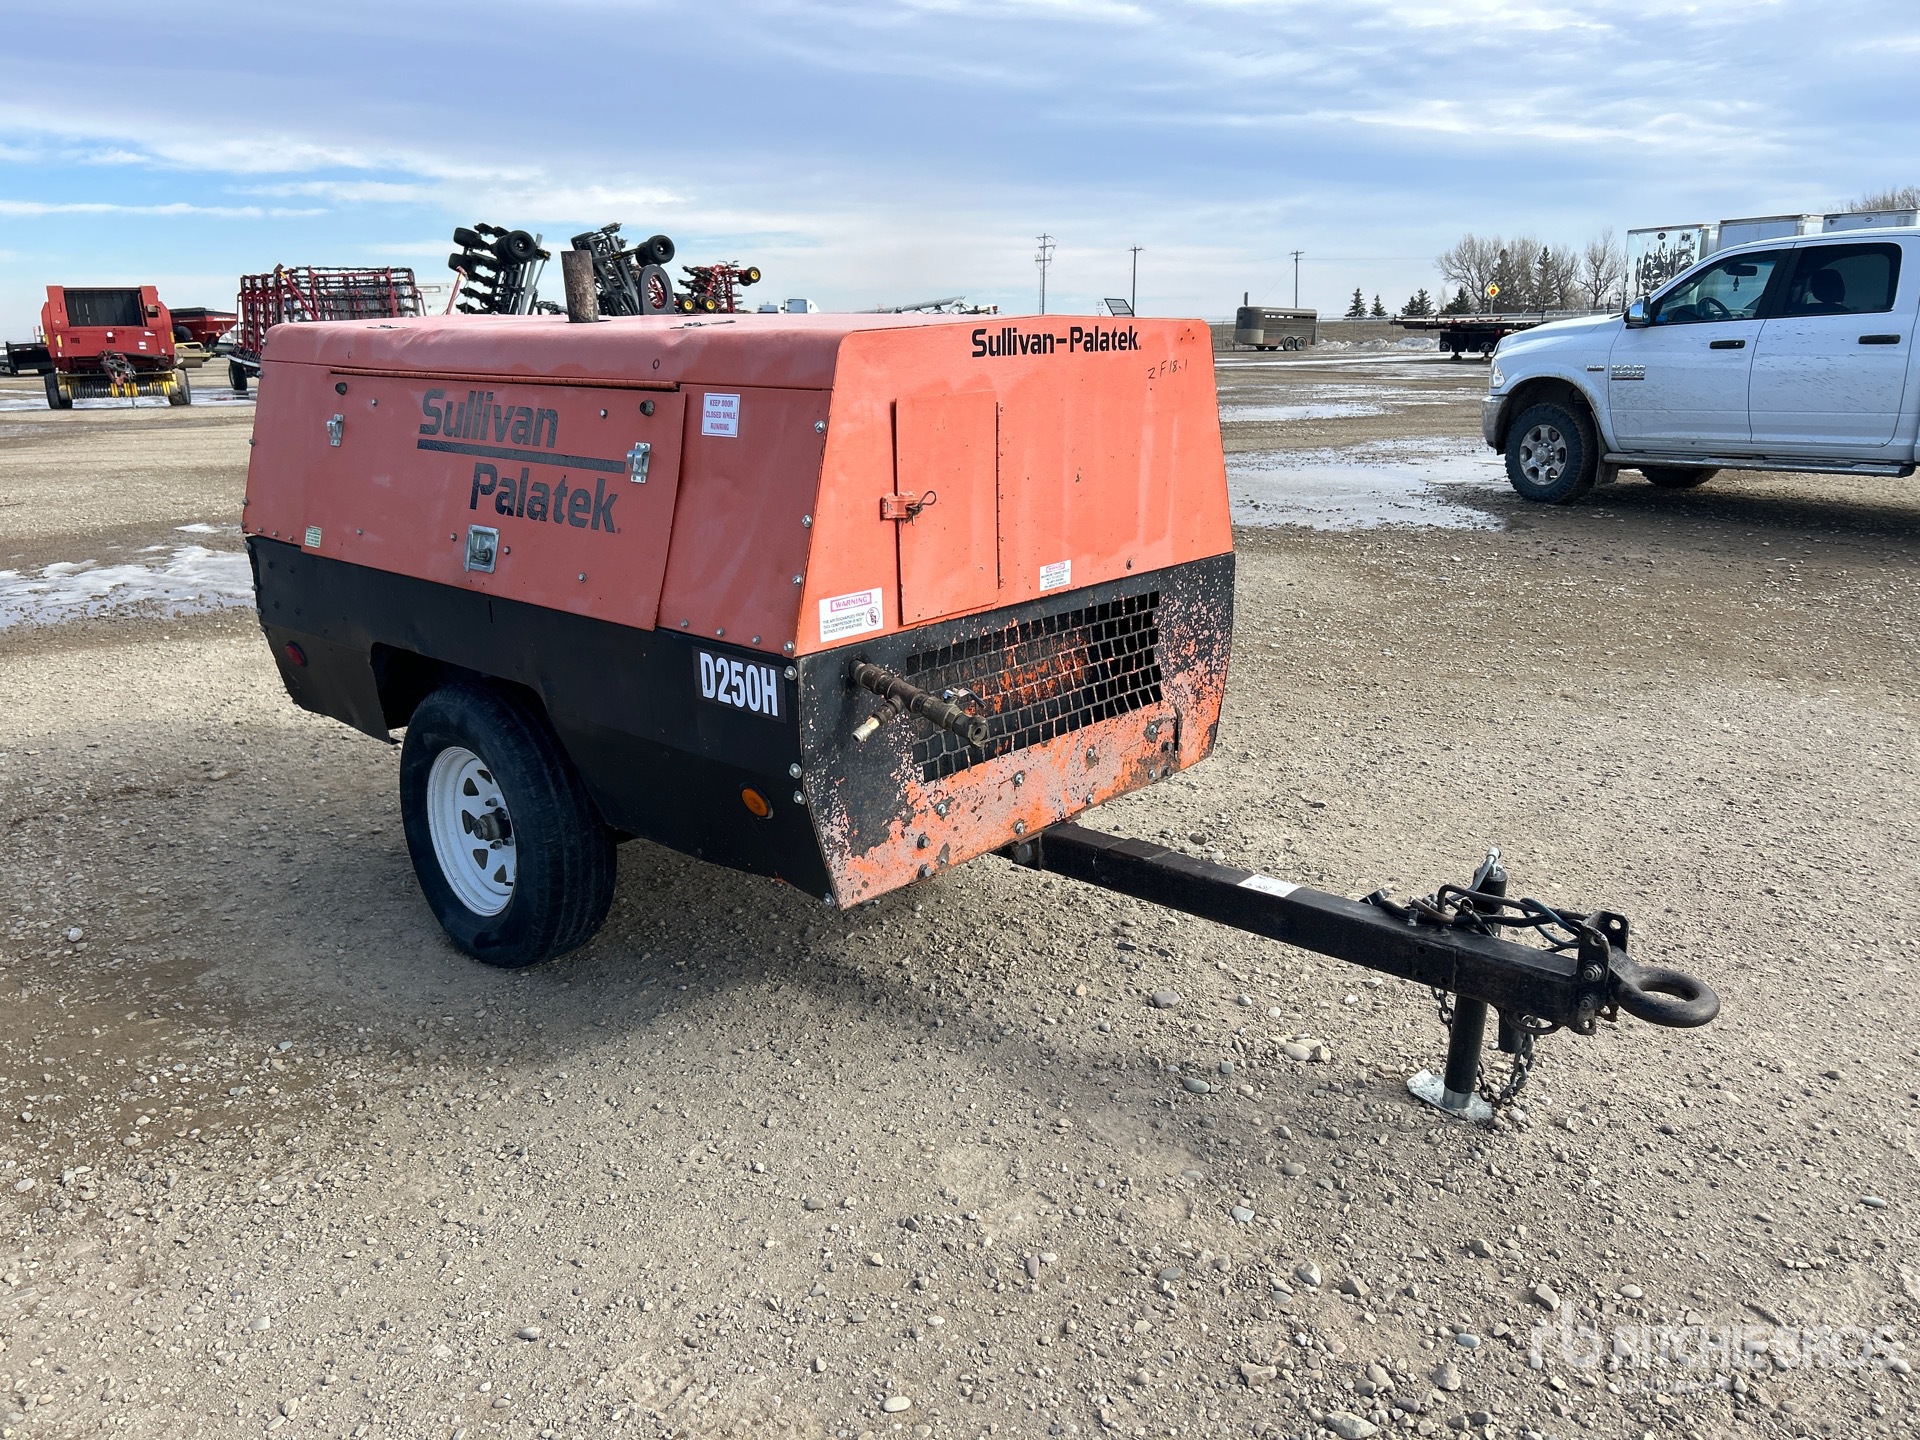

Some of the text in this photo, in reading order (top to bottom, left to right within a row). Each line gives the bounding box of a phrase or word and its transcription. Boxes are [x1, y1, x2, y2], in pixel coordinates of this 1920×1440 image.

[419, 388, 559, 448] Sullivan
[723, 411, 735, 420] WHILE
[469, 462, 618, 534] Palatek
[835, 596, 867, 608] WARNING
[699, 651, 779, 717] D250H
